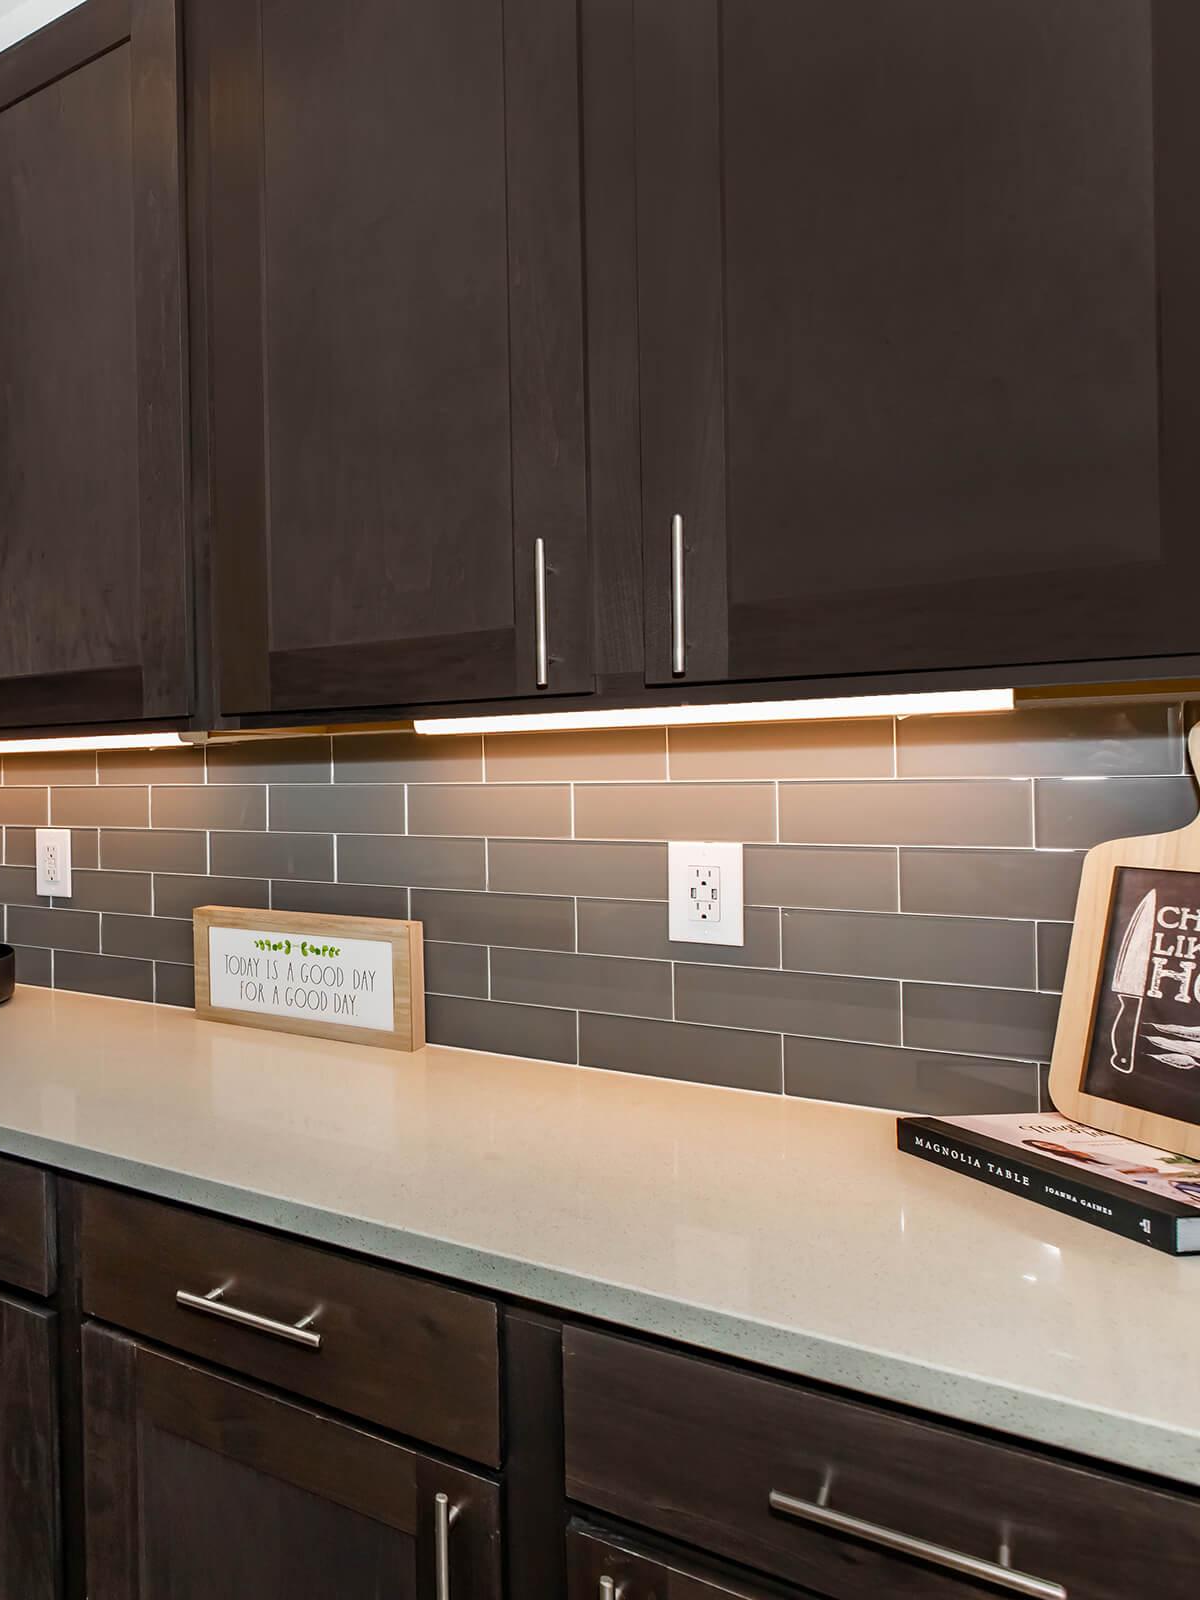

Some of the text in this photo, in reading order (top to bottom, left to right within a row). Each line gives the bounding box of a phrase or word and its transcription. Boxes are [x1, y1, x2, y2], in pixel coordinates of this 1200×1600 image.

[224, 954, 376, 993] TODAY IS A GOOD DAY
[240, 980, 359, 1017] FOR A GOOD DAY.
[914, 1136, 1113, 1216] MAGNOLIA TABLE JOANNA GAINES
